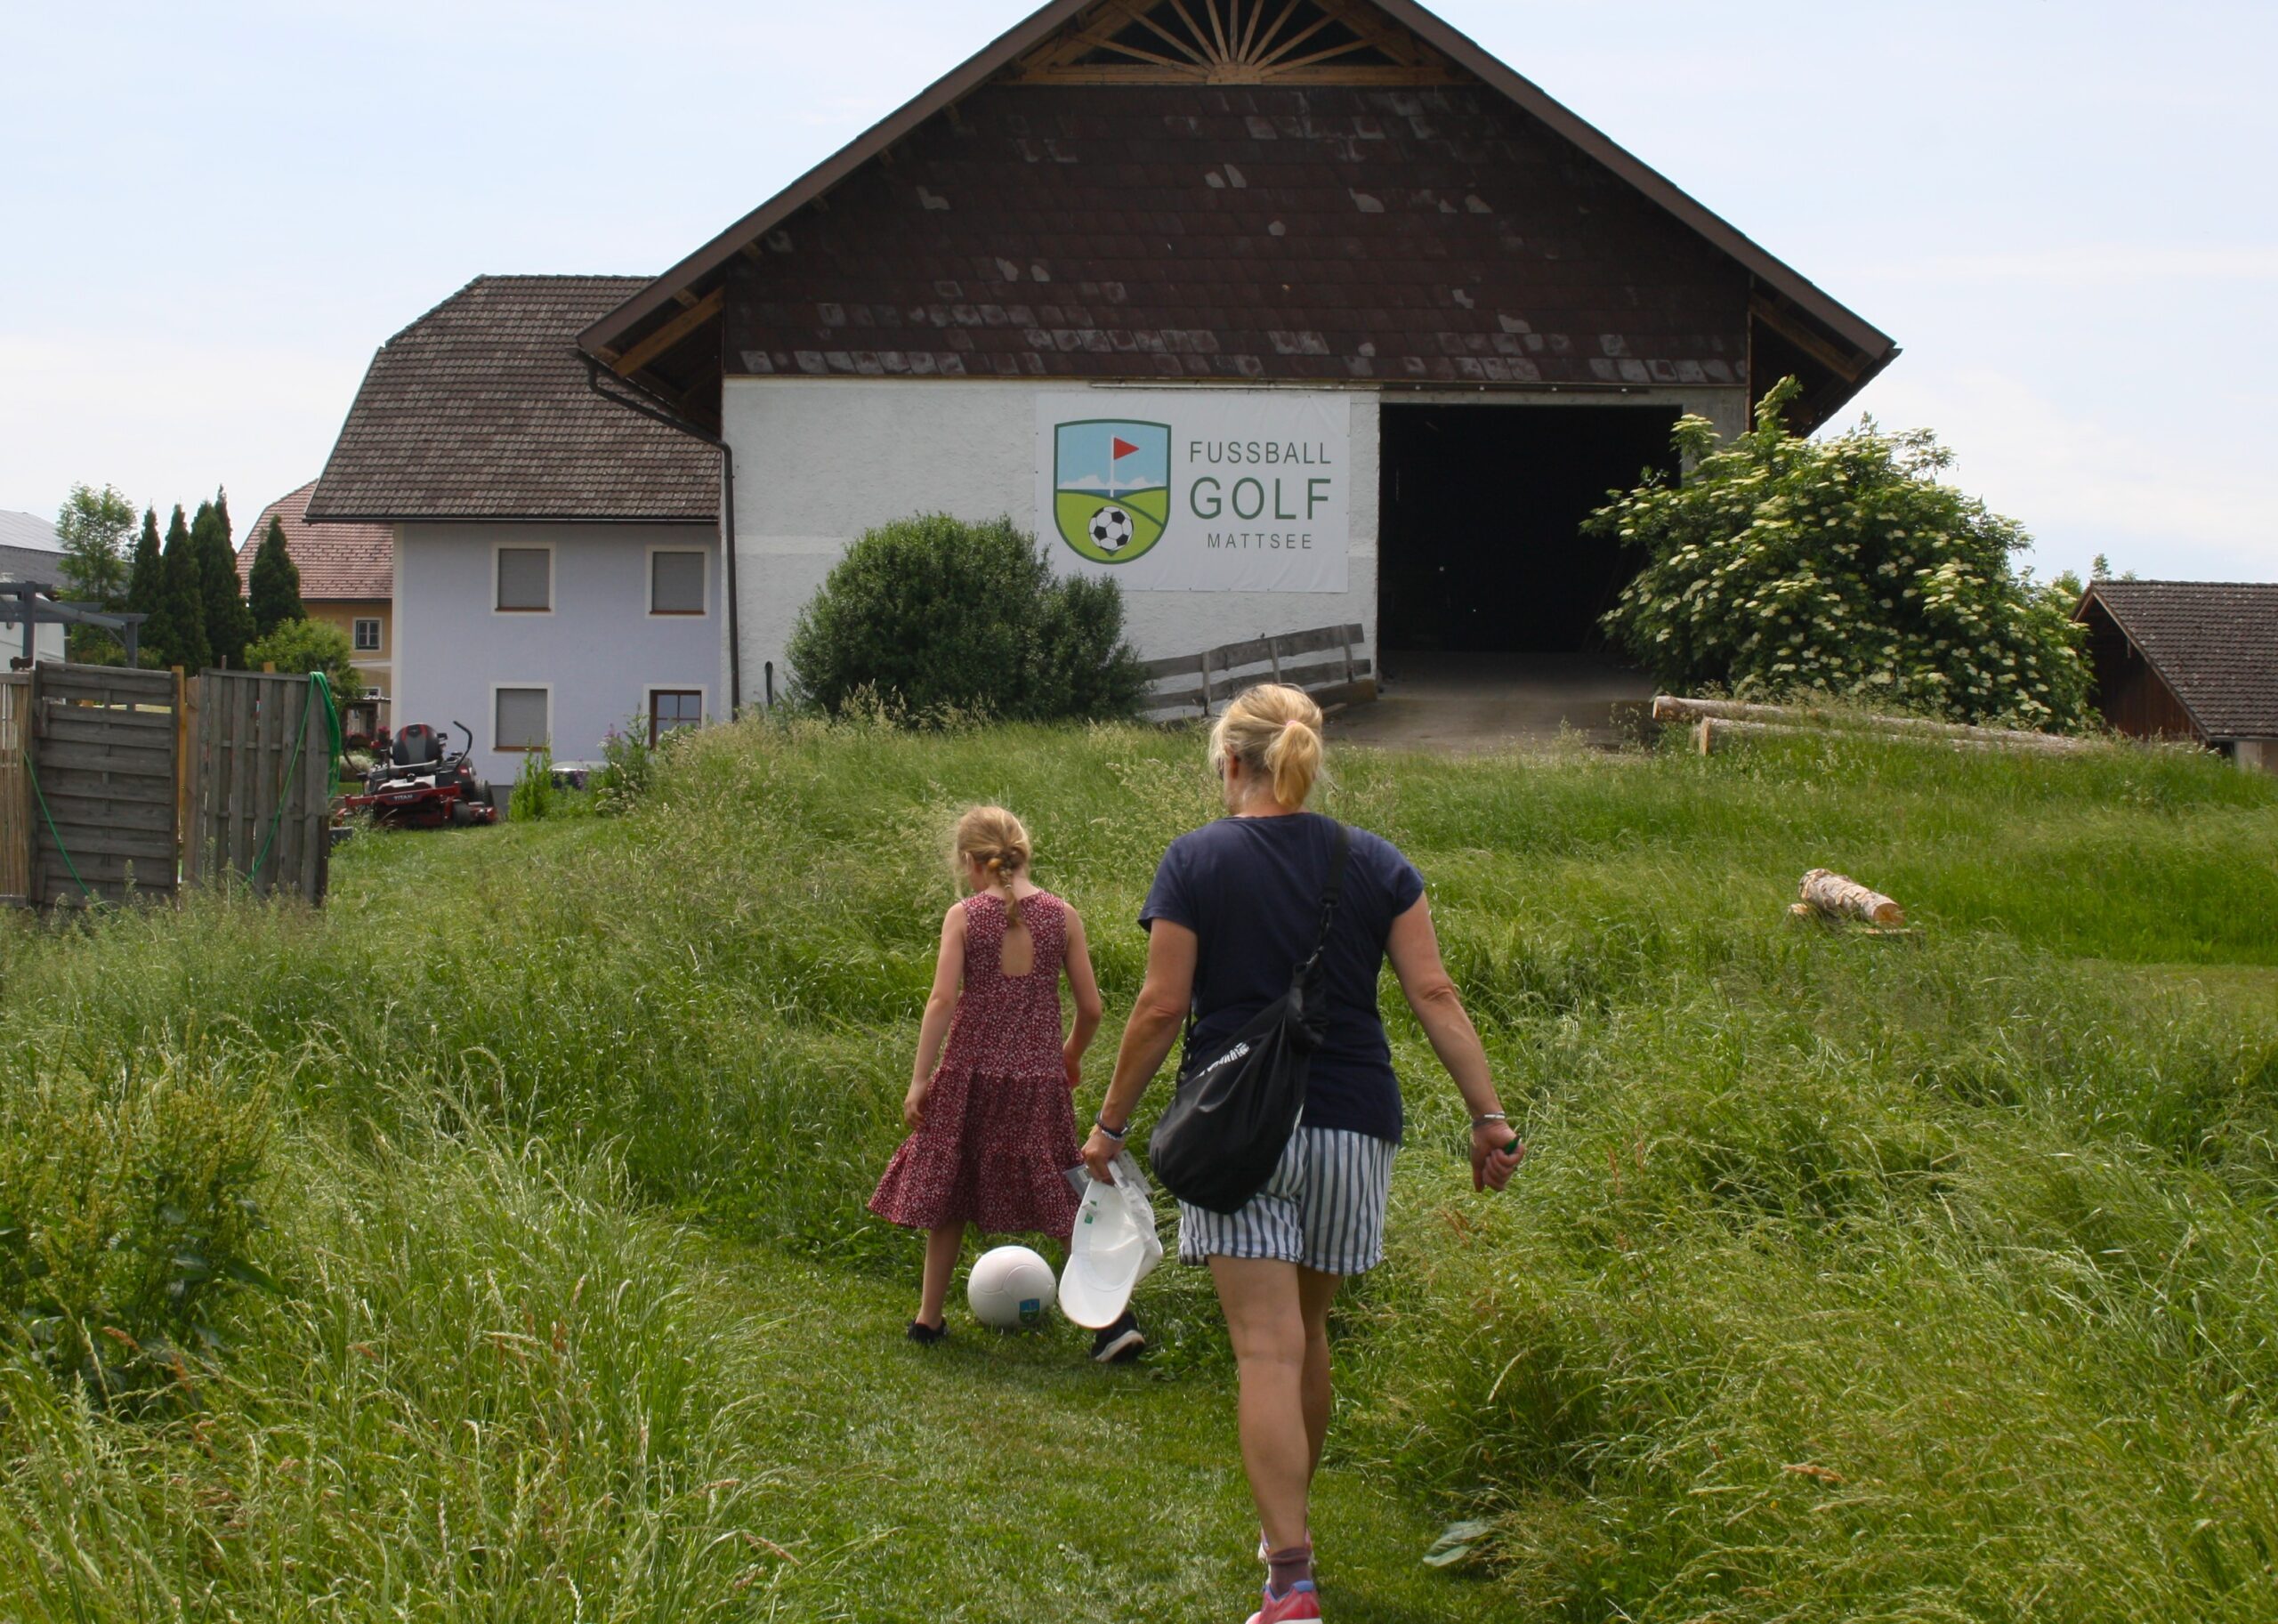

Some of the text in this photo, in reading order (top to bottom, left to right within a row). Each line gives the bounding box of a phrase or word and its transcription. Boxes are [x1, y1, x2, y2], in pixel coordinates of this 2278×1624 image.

[1190, 440, 1332, 465] FUSSBALL
[1189, 476, 1332, 521] GOLF
[1207, 533, 1313, 549] MATTSEE
